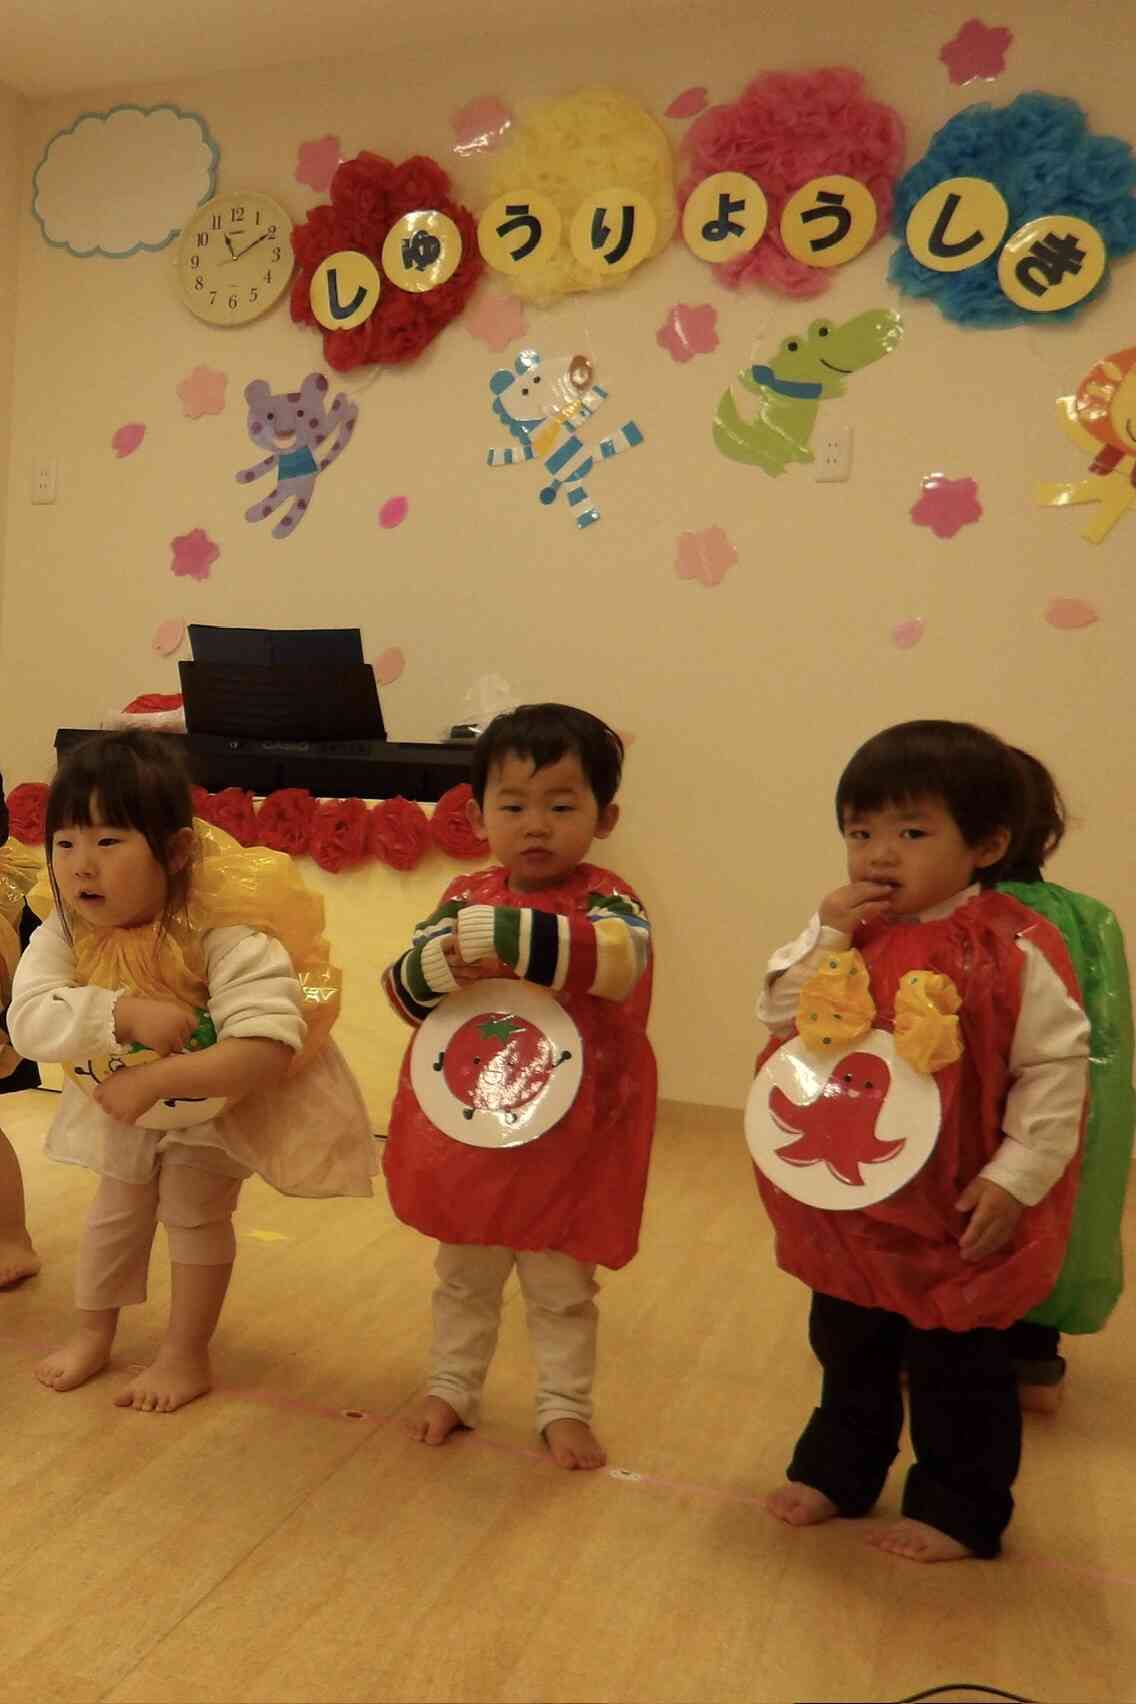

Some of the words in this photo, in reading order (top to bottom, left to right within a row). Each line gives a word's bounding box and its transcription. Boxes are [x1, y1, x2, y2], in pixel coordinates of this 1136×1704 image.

[230, 207, 245, 222] 12
[255, 210, 260, 226] 1
[211, 215, 222, 230] 11
[196, 231, 209, 248] 10
[267, 225, 277, 240] 2
[190, 255, 200, 270] 9
[271, 247, 281, 263] 3
[194, 275, 204, 291] 8
[264, 269, 272, 284] 4
[209, 290, 217, 305] 7
[228, 294, 238, 310] 6
[249, 288, 258, 303] 5
